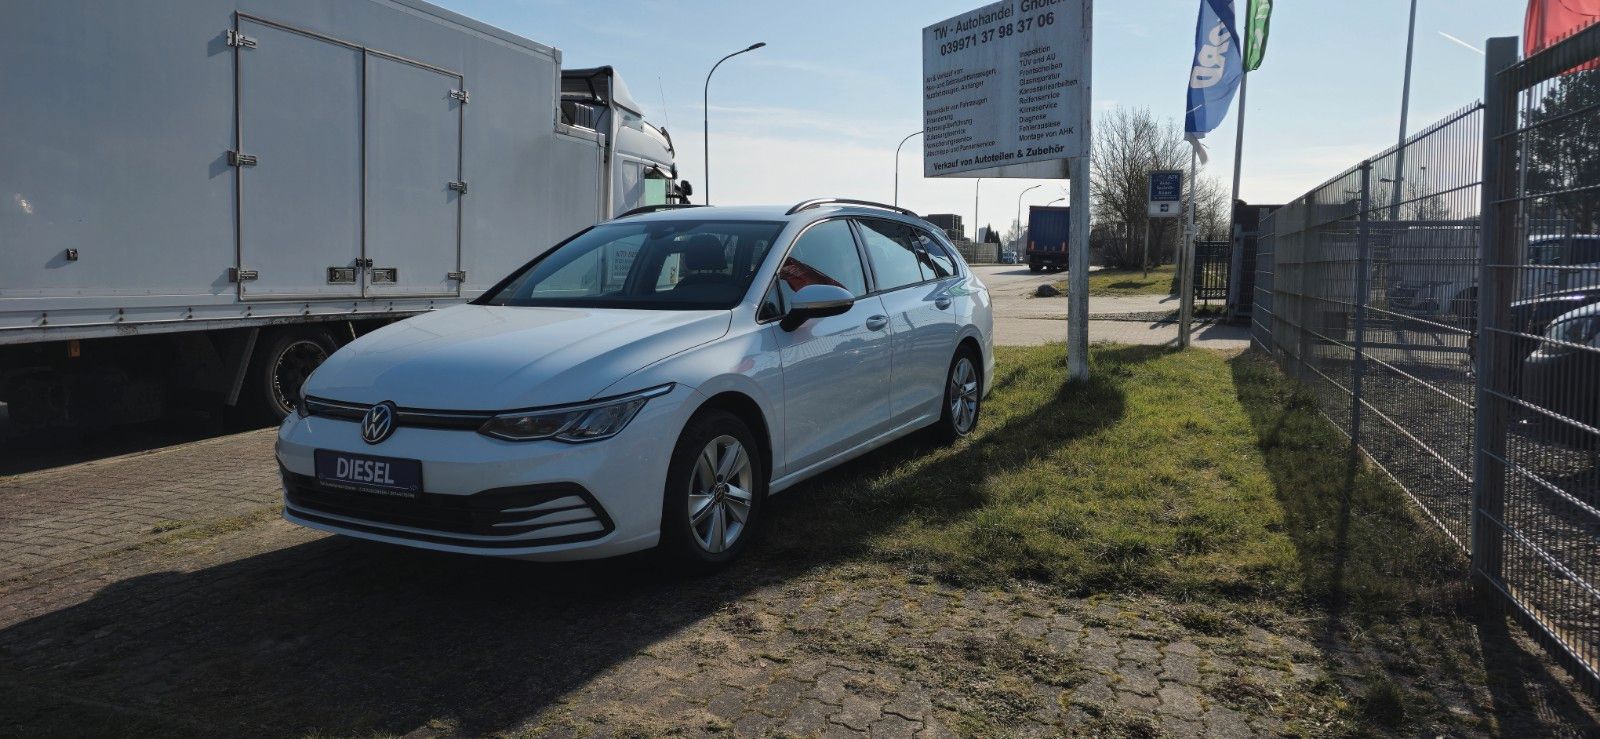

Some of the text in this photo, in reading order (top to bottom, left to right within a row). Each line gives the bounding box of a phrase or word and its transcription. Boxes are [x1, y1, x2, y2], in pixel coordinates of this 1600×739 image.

[934, 26, 948, 40] TW
[956, 4, 1014, 33] Autohandel
[940, 11, 1055, 56] 039971 37 98 37 06
[1019, 45, 1051, 58] Inspektion
[1019, 52, 1057, 67] TÜV und AU
[1019, 62, 1063, 76] Frontscheiben
[1019, 80, 1078, 95] Karosseriearbeiten
[1019, 92, 1061, 105] Reifenservice
[1019, 102, 1058, 114] Klimaservice
[1019, 113, 1048, 124] Diagnose
[1019, 121, 1061, 132] Fehlerauslese
[1019, 126, 1075, 142] Montage von AHK
[933, 144, 1065, 171] Verkauf von Autoteilen & Zubehör
[336, 457, 394, 485] DIESEL
